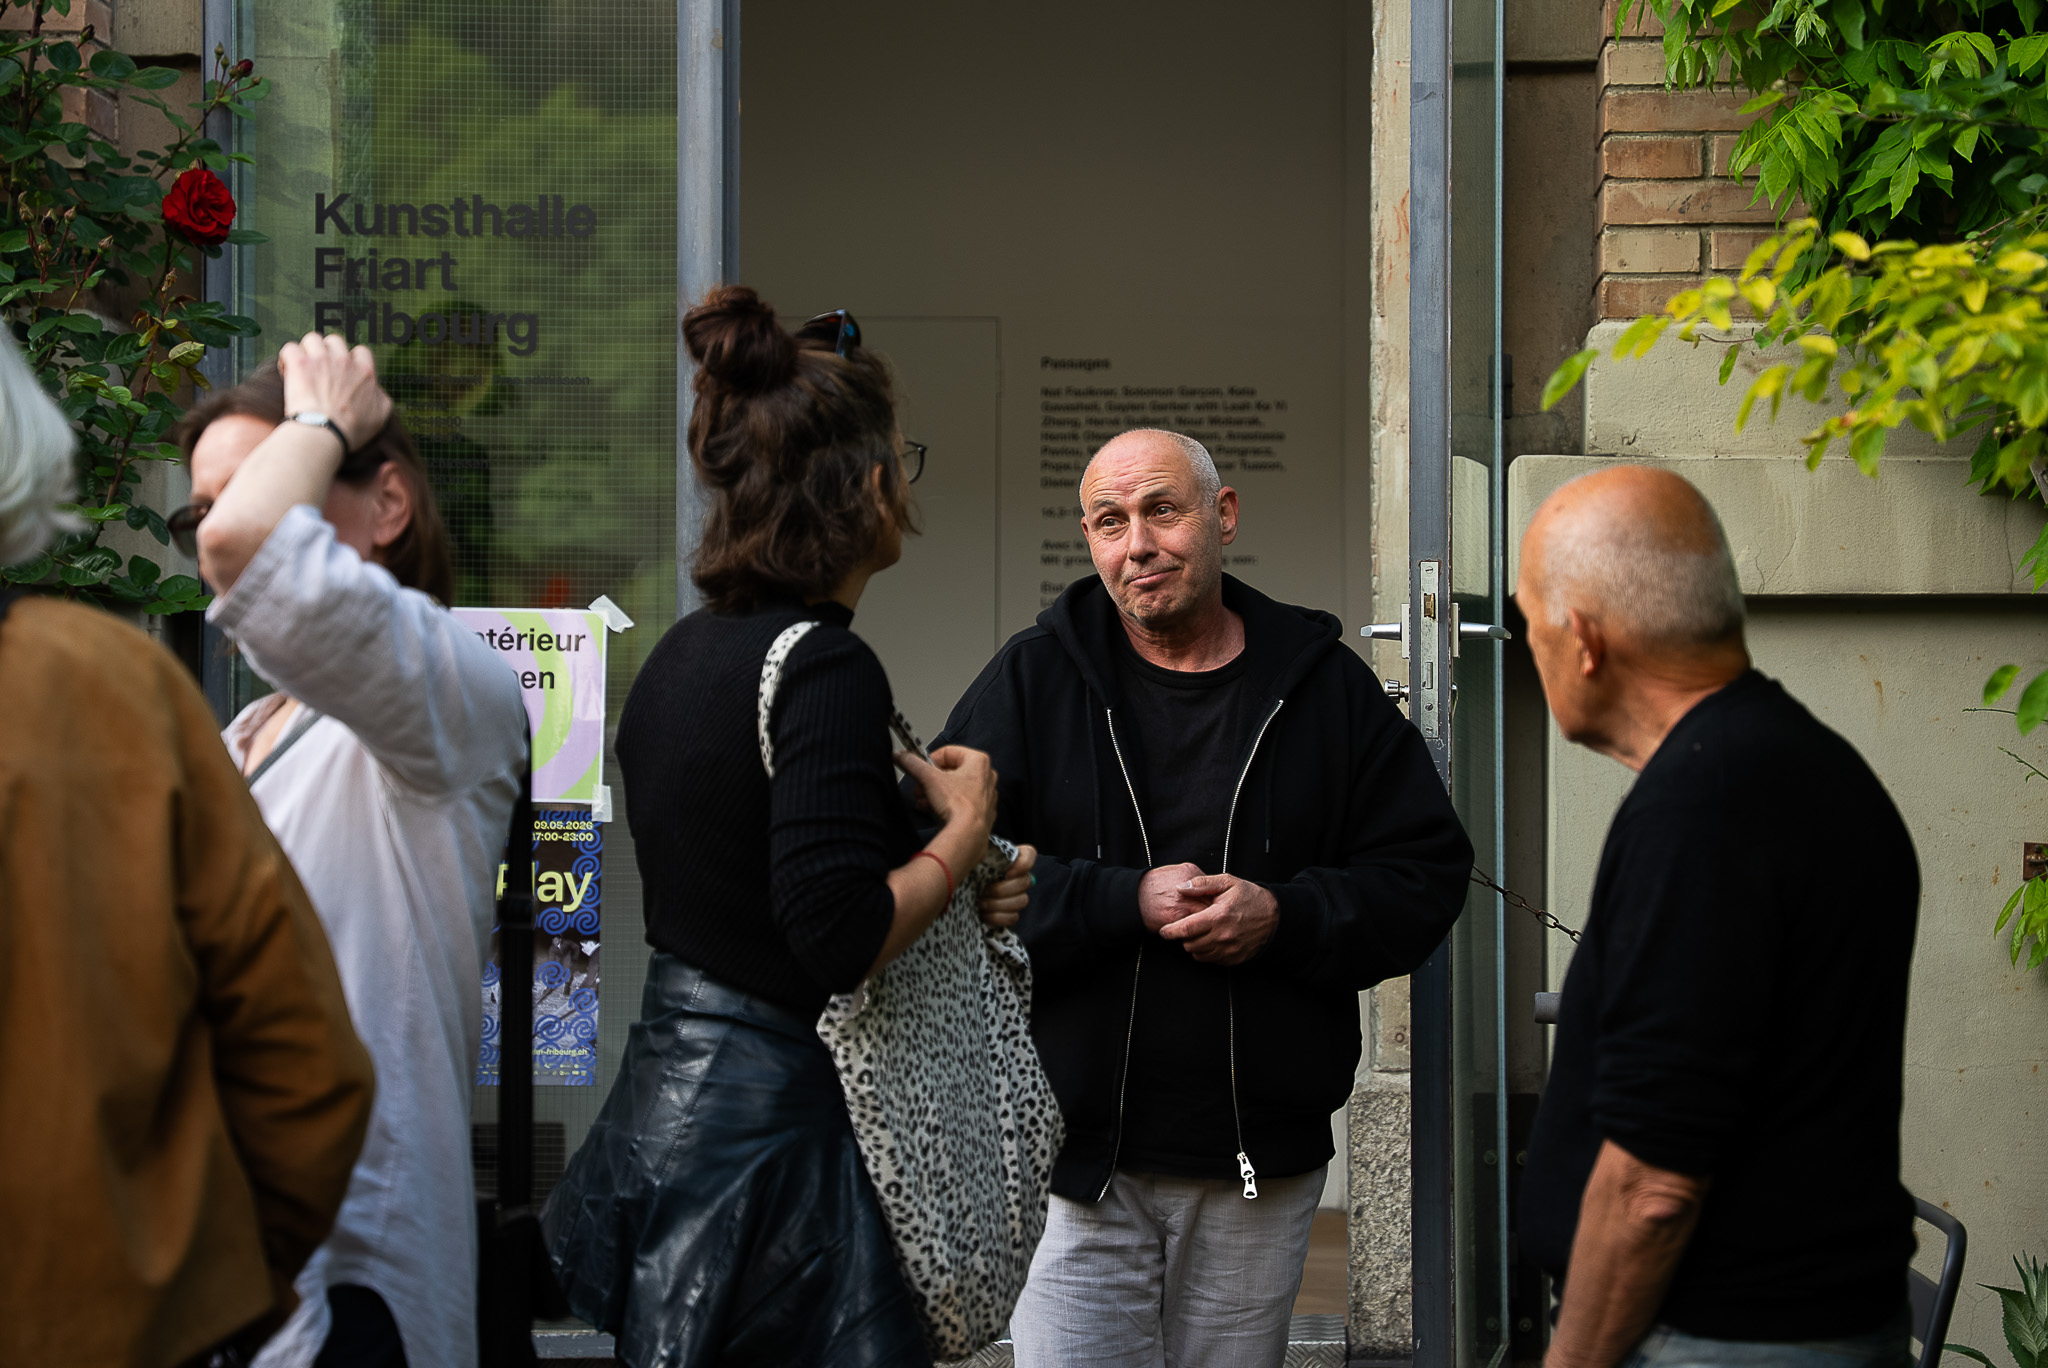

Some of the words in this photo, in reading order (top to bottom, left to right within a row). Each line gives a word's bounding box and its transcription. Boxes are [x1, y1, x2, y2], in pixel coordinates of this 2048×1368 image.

[315, 193, 597, 238] Kunsthalle
[315, 247, 459, 291] Friart
[315, 302, 539, 356] Fribourg
[1041, 356, 1111, 371] Passages
[1194, 401, 1218, 412] with
[512, 670, 555, 689] en
[534, 820, 593, 830] 09.05.2026
